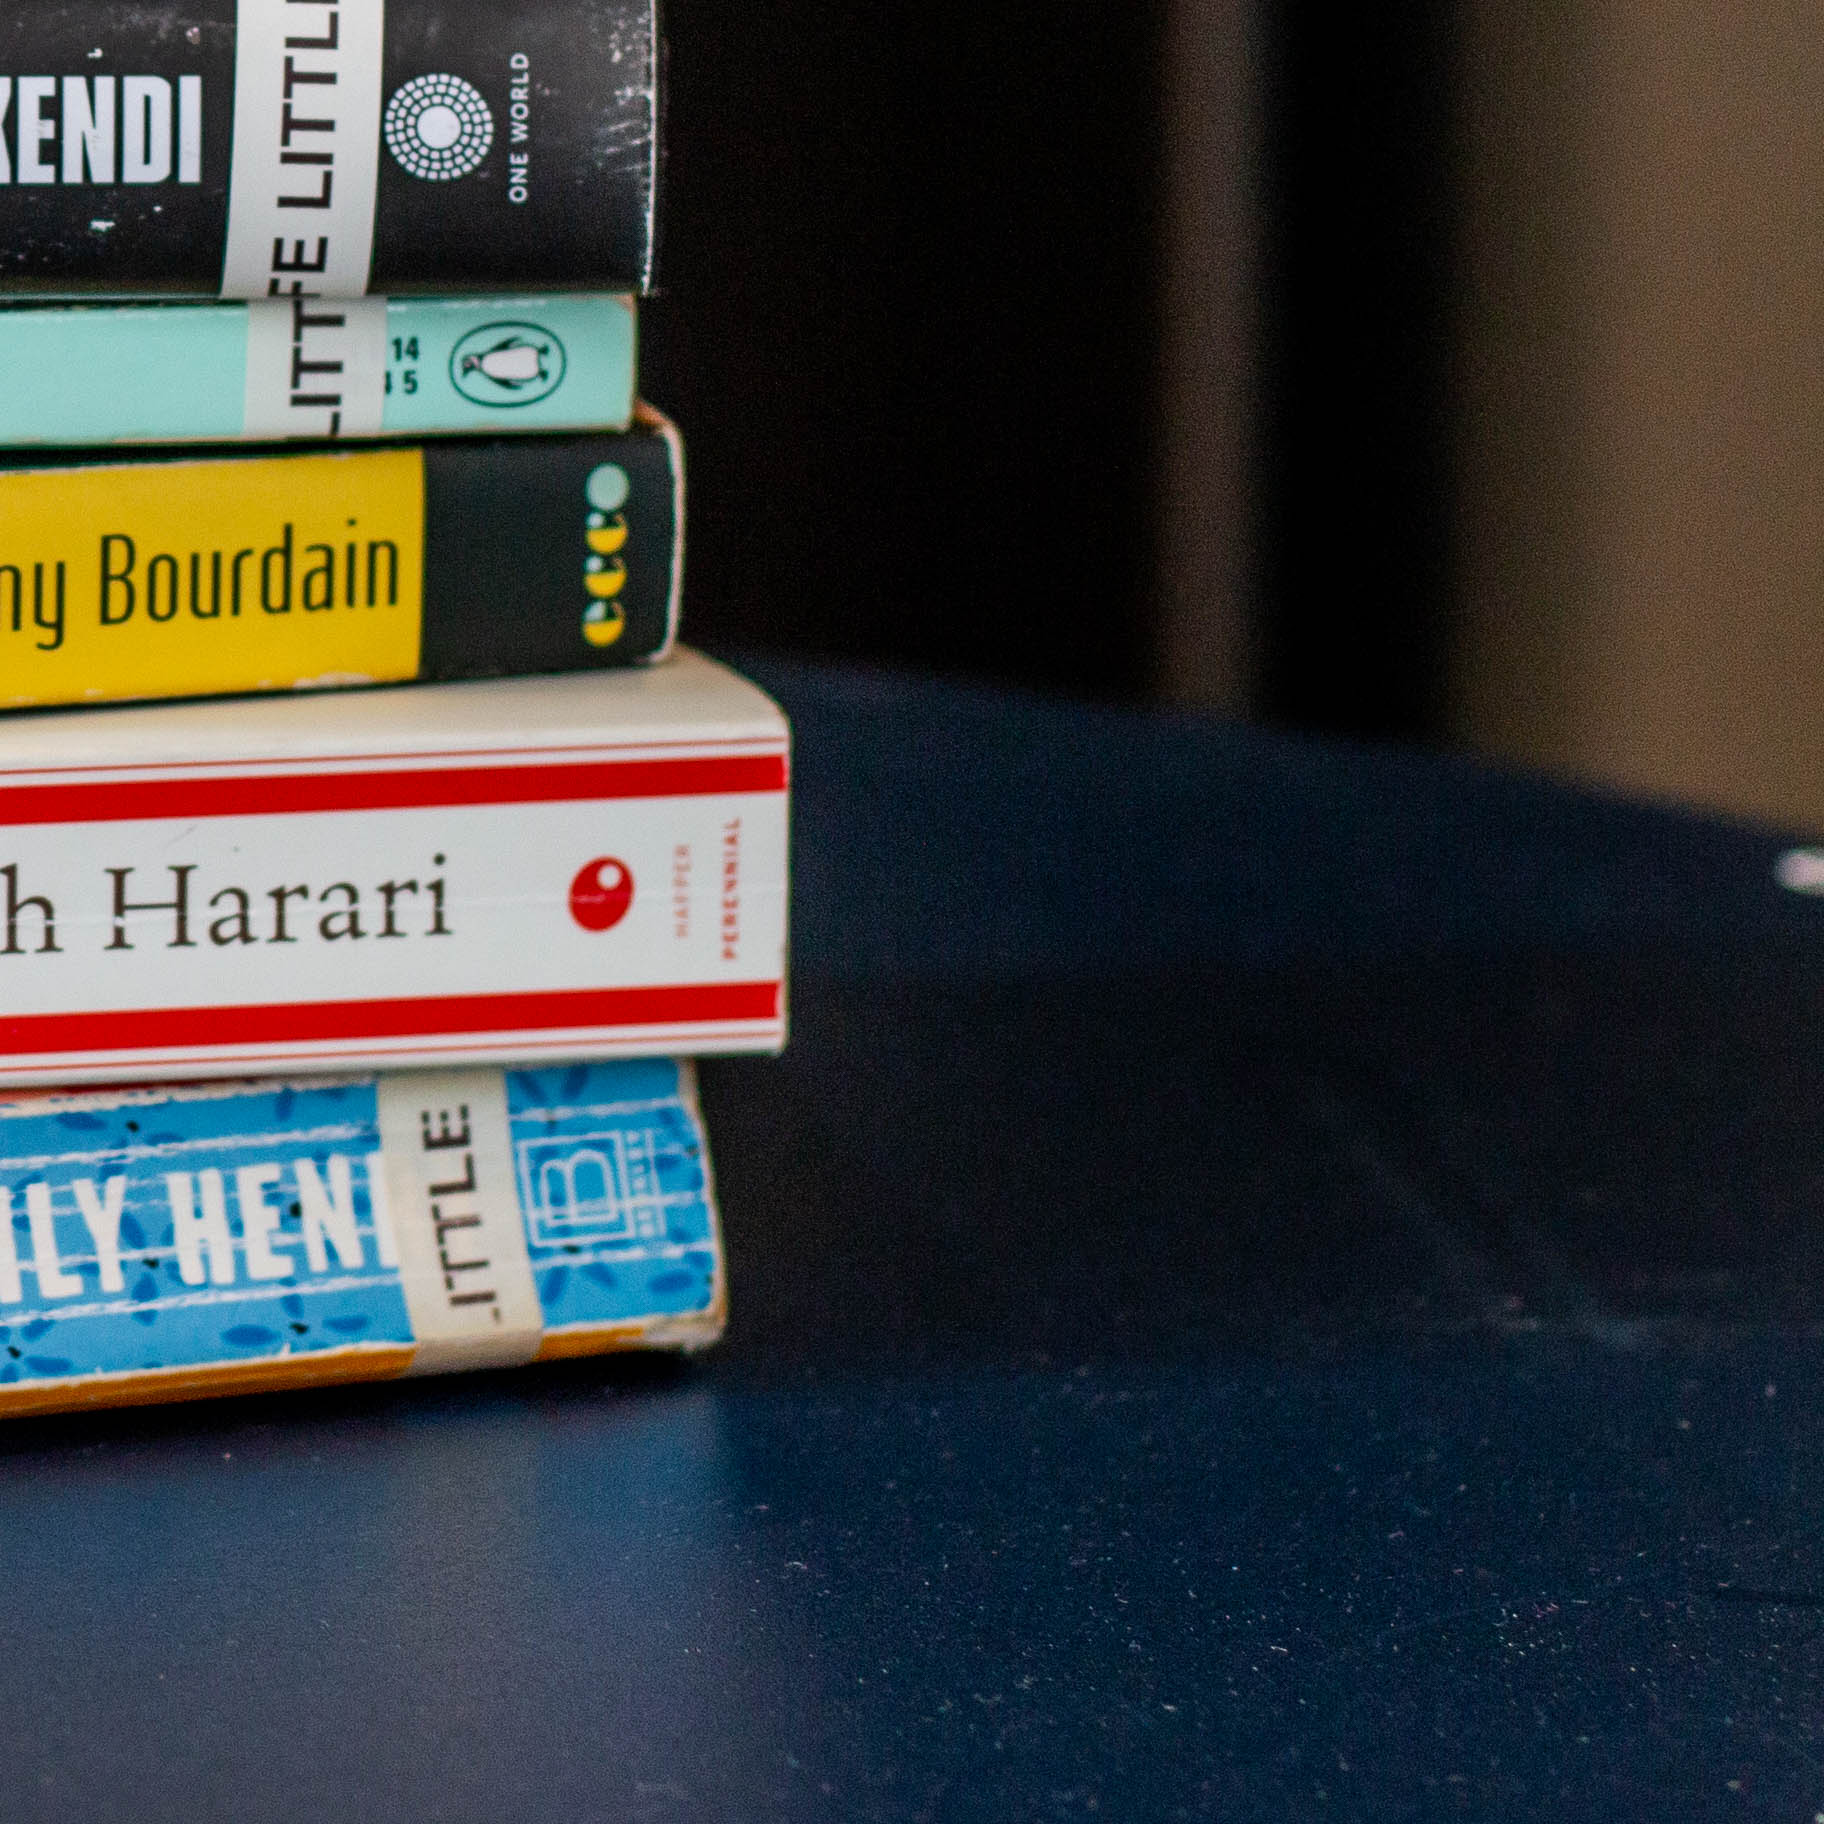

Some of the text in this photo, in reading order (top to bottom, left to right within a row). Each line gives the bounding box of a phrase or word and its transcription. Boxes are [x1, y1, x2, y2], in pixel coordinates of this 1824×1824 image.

[508, 50, 531, 204] ONE WORLD
[98, 517, 401, 628] Bourdain
[103, 853, 454, 950] Harari
[421, 1102, 502, 1325] ITTLE
